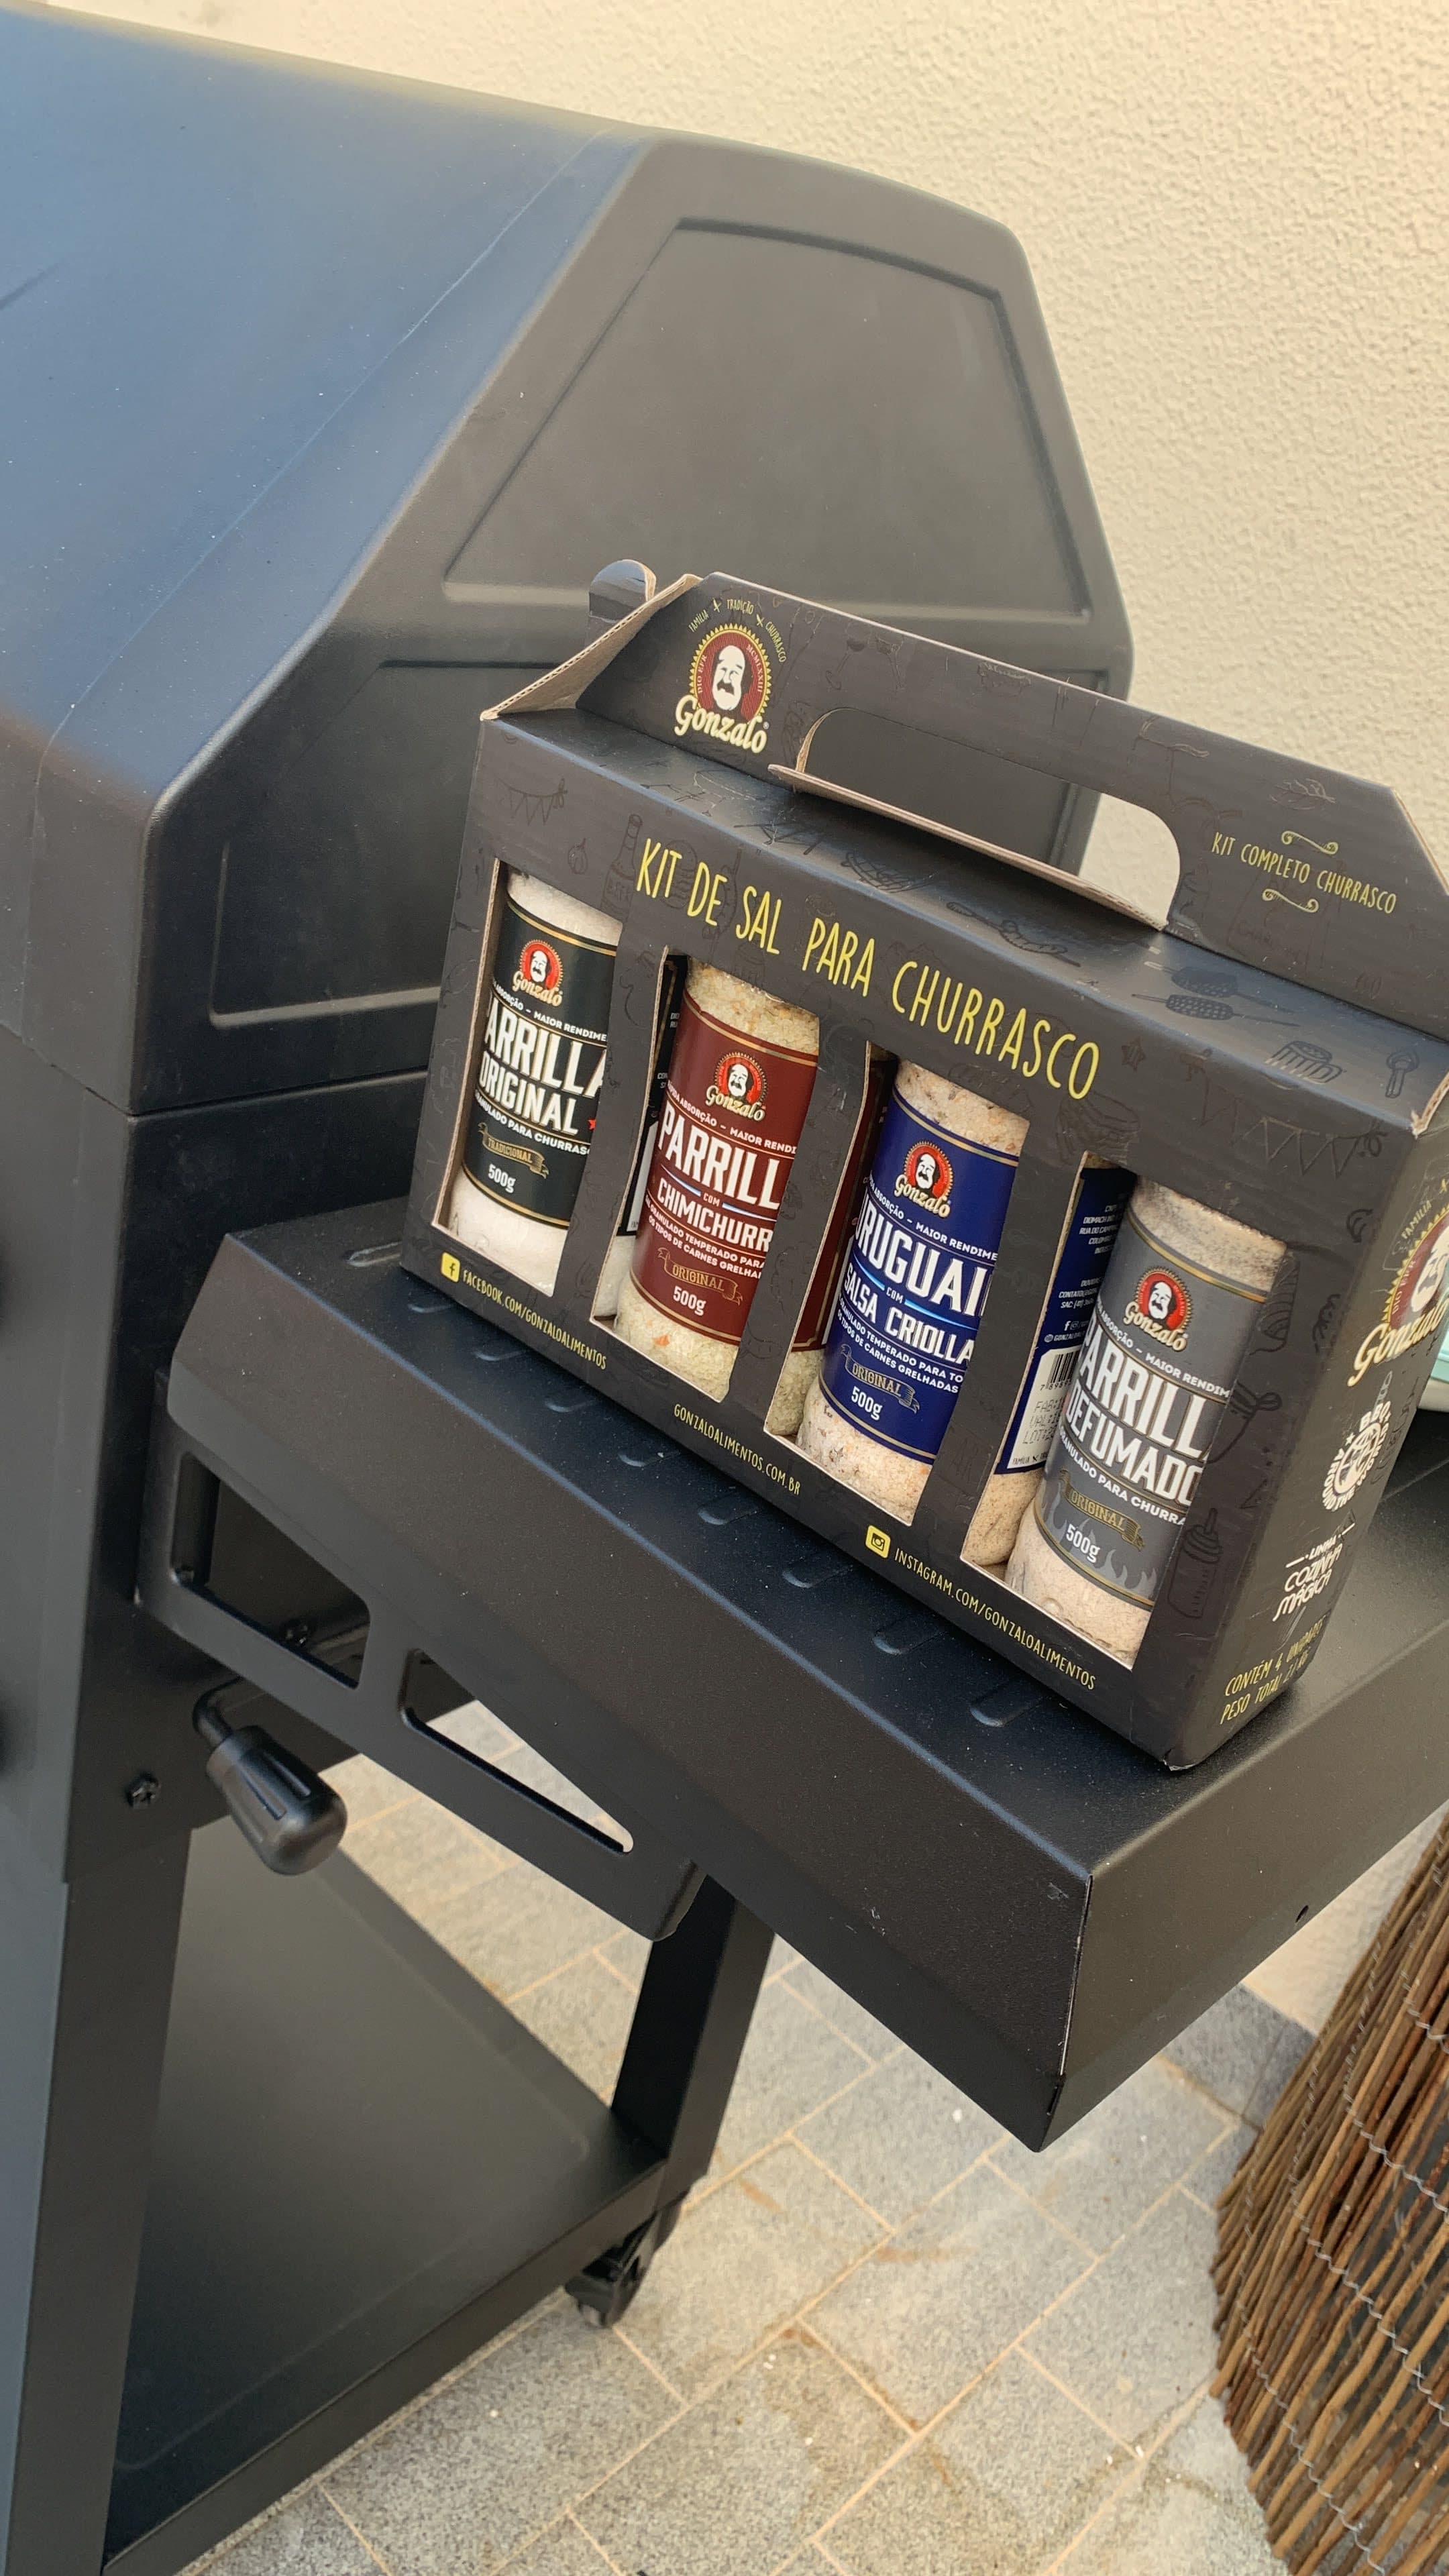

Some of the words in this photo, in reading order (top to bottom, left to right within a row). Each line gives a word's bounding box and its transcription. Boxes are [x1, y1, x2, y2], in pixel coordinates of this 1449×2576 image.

[688, 609, 709, 633] FAMÍLIA
[727, 598, 755, 614] TRADIÇÃO
[765, 621, 787, 663] CHURRASCO
[674, 694, 767, 753] Gonzalo
[1212, 832, 1236, 856] KIT
[1240, 843, 1310, 883] COMPLETO
[1316, 870, 1397, 914] CHURRASCO
[512, 971, 562, 1006] Gonzalo
[636, 838, 682, 899] KIT
[687, 861, 728, 926] DE
[735, 885, 782, 955] SAL
[802, 917, 875, 997] PARA
[892, 961, 1100, 1100] CHURRASCO
[485, 990, 607, 1098] ARRILLA
[533, 1011, 562, 1029] MAIOR
[564, 1023, 607, 1042] RENDIME
[479, 1051, 578, 1136] ORIGINAL
[706, 1085, 765, 1122] Gonzalo
[488, 1137, 533, 1163] TRADICIONAL
[508, 1120, 533, 1139] PARA
[680, 1097, 717, 1128] ABSORÇÃO
[730, 1127, 762, 1146] MAIOR
[764, 1140, 797, 1155] RENDI
[488, 1163, 516, 1193] 500g
[657, 1100, 780, 1210] PARRILL
[656, 1177, 773, 1252] CHIMICHURR
[703, 1193, 720, 1207] COM
[894, 1174, 951, 1218] Gonzalo
[1401, 1199, 1432, 1239] FAMÍLIA
[650, 1204, 684, 1238] GRANULADO
[686, 1232, 738, 1262] TEMPERADO
[874, 1187, 904, 1220] ABSORÇÃO
[915, 1222, 947, 1244] MAIOR
[949, 1239, 999, 1261] RENDIME
[655, 1222, 672, 1242] TIPOS
[673, 1237, 683, 1248] DE
[683, 1244, 718, 1266] CARNES
[719, 1261, 761, 1279] GRELHA
[855, 1186, 993, 1316] URUGUAI
[672, 1265, 724, 1292] ORIGINAL
[673, 1285, 706, 1316] 500g
[886, 1287, 903, 1304] COM
[462, 1269, 606, 1370] FACEBOOK.COM/GONZALOALIMENTOS
[844, 1263, 878, 1324] SALSA
[885, 1306, 975, 1364] CRIOLLA
[1123, 1301, 1187, 1351] Gonzalo
[841, 1316, 855, 1338] TIPOS
[855, 1334, 863, 1347] DE
[864, 1343, 896, 1368] CARNES
[898, 1364, 959, 1393] GRELHADAS
[852, 1362, 902, 1397] ORIGINAL
[867, 1330, 917, 1366] TEMPERADO
[918, 1362, 946, 1379] PARA
[1145, 1352, 1183, 1379] MAIOR
[1183, 1373, 1230, 1399] RENDIM
[851, 1386, 883, 1421] 500g
[1079, 1313, 1208, 1459] PARRILL
[674, 1403, 800, 1495] GONZALOALIMENTOS.COM.BR
[1065, 1379, 1204, 1505] DEFUMADO
[1070, 1491, 1126, 1532] ORIGINAL
[1098, 1475, 1128, 1501] PARA
[1131, 1497, 1187, 1525] CHURRA
[1066, 1523, 1101, 1563] 500g
[1284, 1543, 1343, 1593] COZINHA
[894, 1548, 1095, 1690] INSTAGRAM.COM/GONZALOALIMENTOS
[1272, 1568, 1332, 1622] MÁGICA
[1220, 1693, 1250, 1725] PESO
[1254, 1673, 1283, 1704] TOTAL
[1225, 1658, 1273, 1697] CONTÉM
[1275, 1652, 1283, 1671] 4
